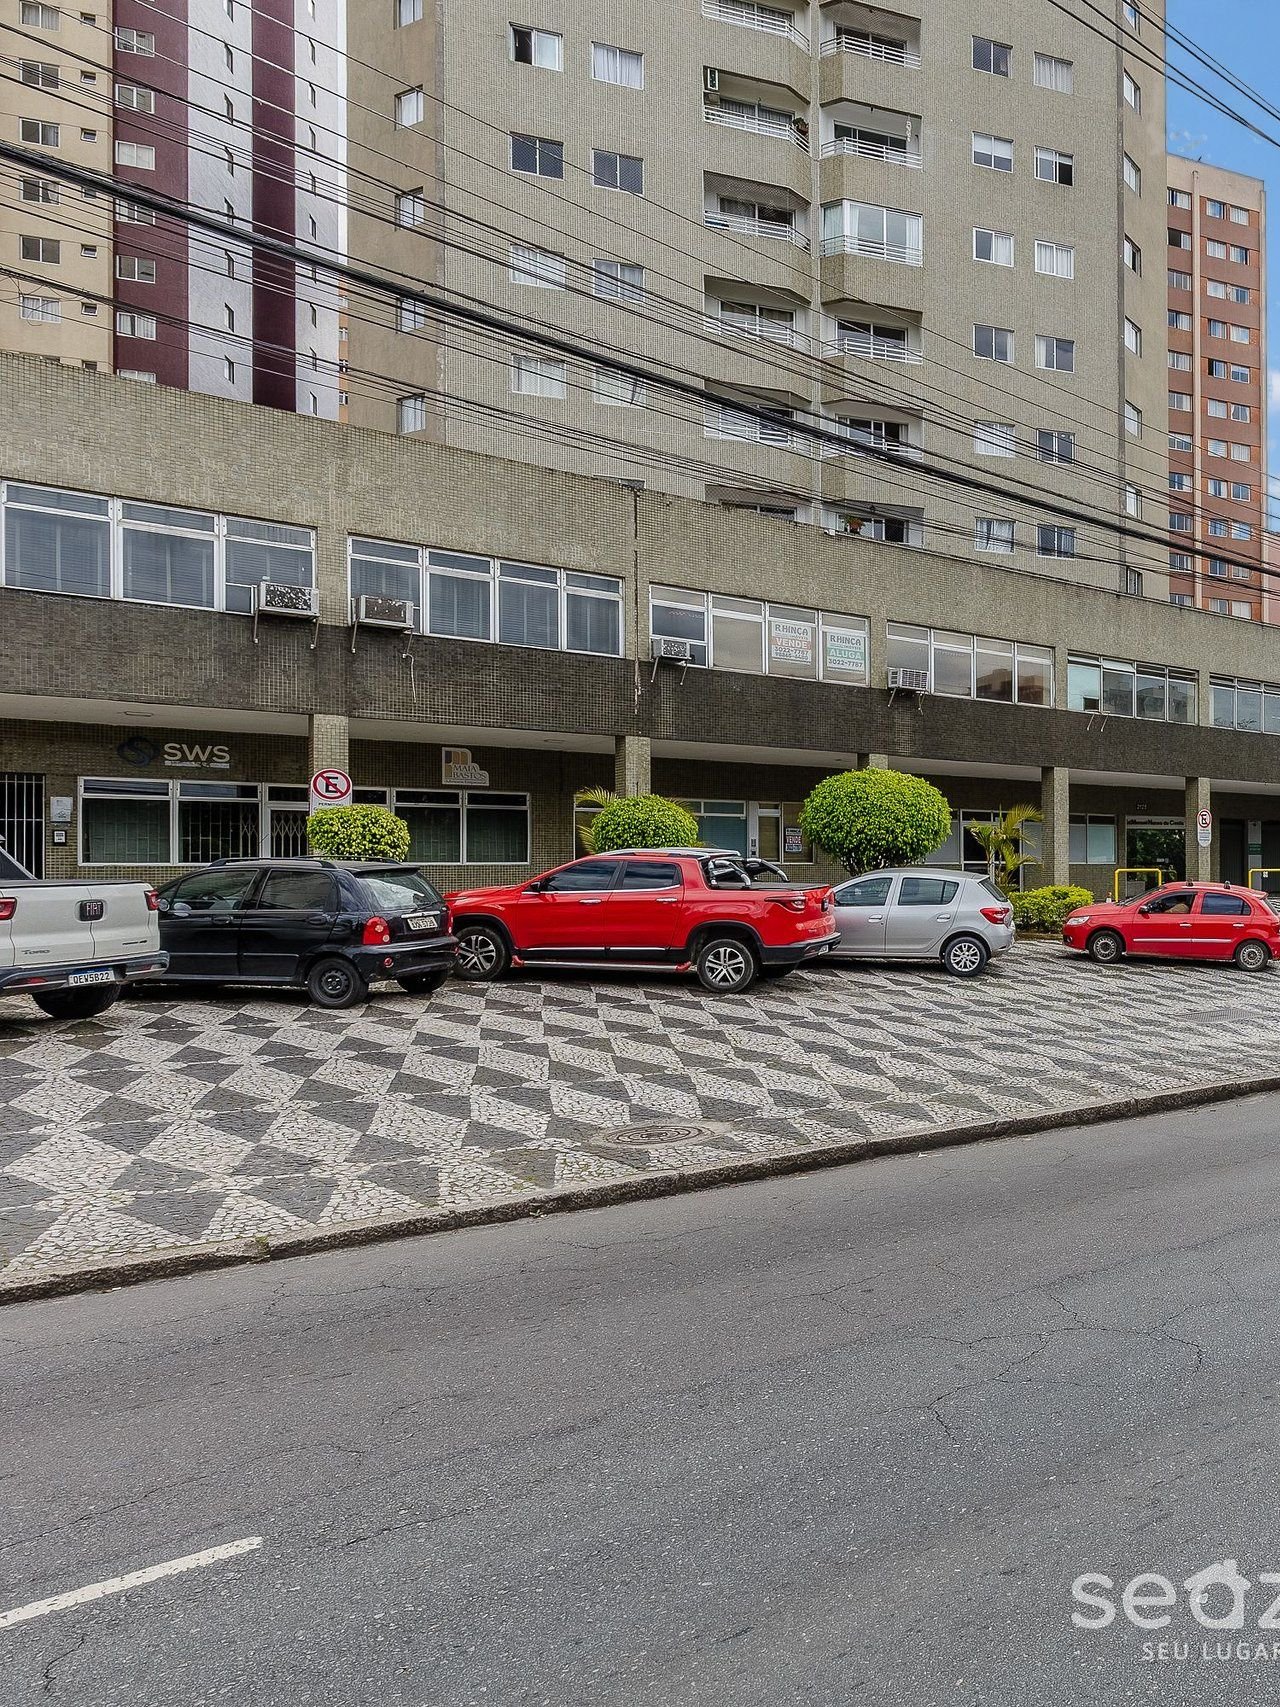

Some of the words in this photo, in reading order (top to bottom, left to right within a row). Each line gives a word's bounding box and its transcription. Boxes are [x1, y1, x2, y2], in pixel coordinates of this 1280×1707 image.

[776, 637, 808, 649] VENDE
[830, 648, 862, 660] ALUGA
[163, 742, 230, 762] SWS
[453, 764, 477, 772] MAIA
[453, 771, 487, 780] BASTOS
[86, 902, 102, 916] FIAT
